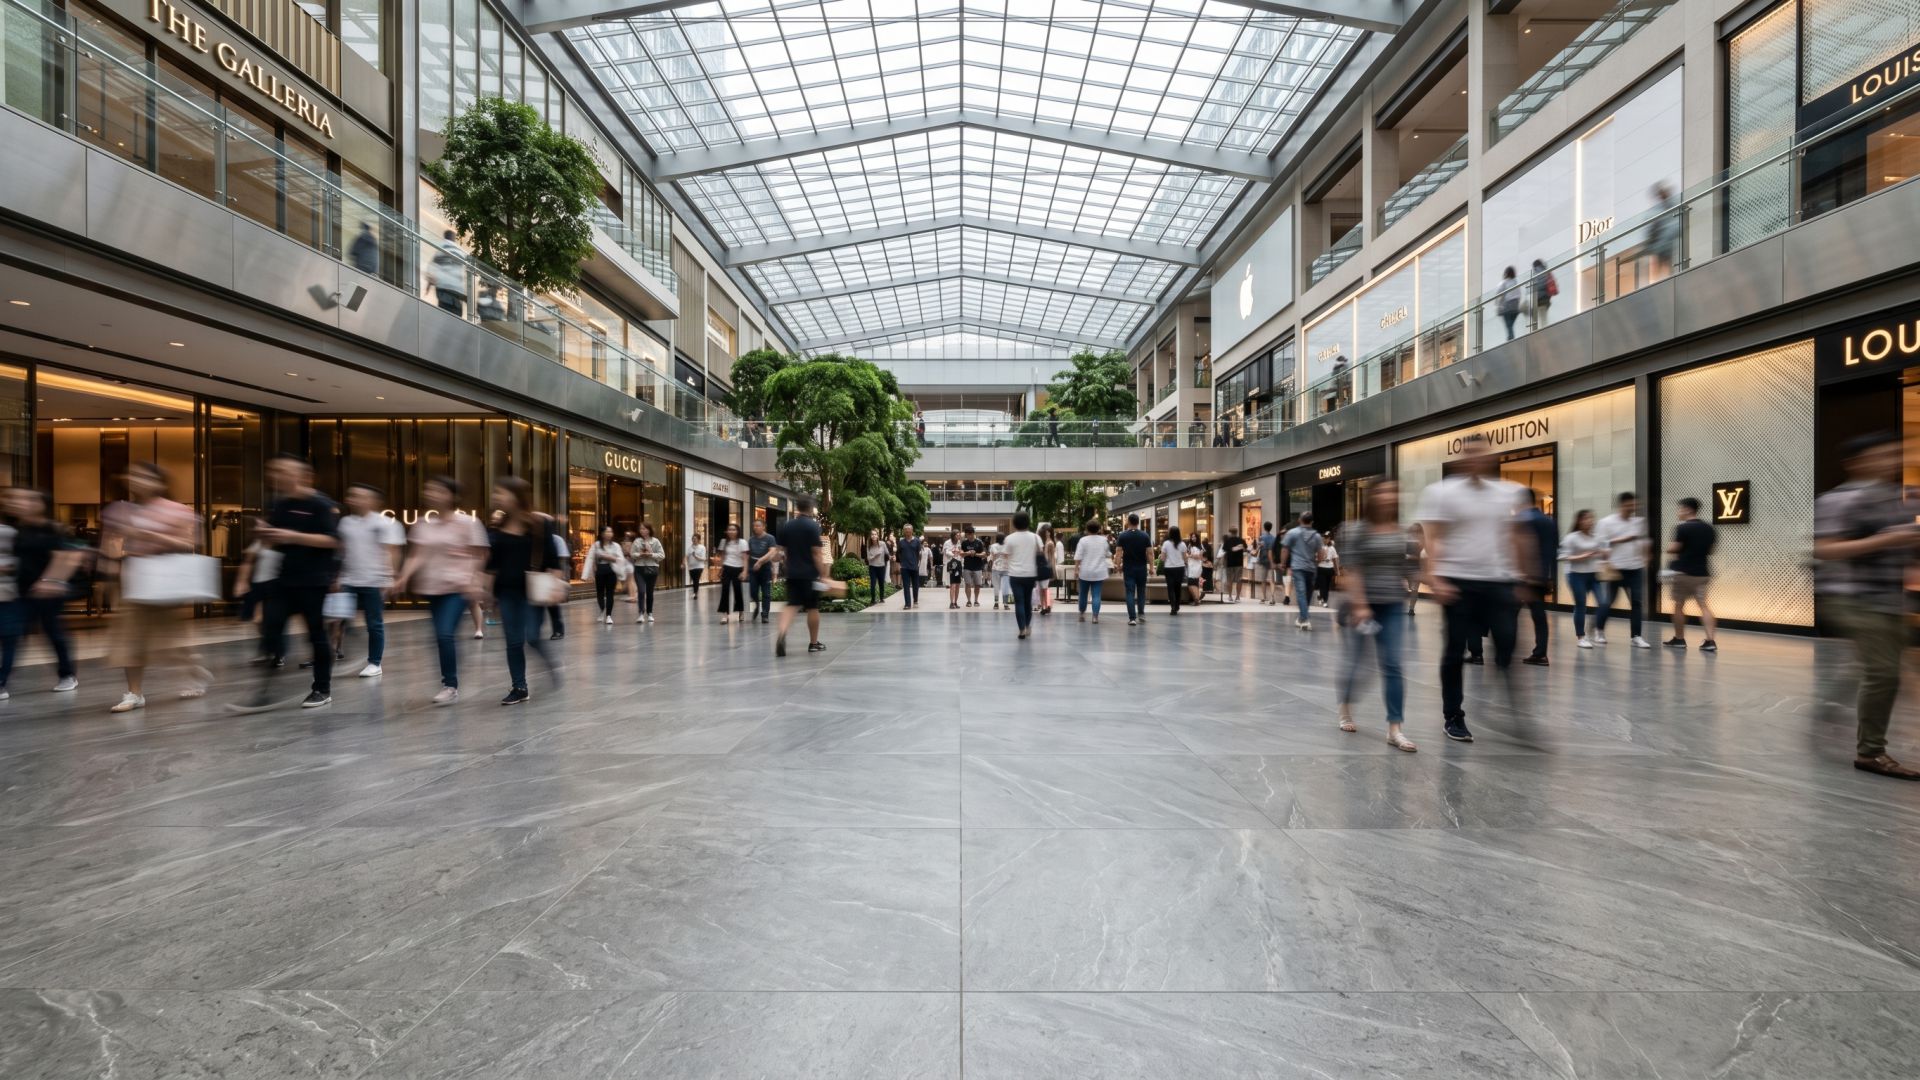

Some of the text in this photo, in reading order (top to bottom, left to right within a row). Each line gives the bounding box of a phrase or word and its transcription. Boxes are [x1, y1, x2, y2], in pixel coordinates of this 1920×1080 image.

[151, 0, 335, 139] THE GALLERIA
[1852, 50, 1920, 104] LOUIS
[1579, 216, 1613, 244] Dior
[1845, 320, 1920, 366] LOU
[1486, 417, 1549, 446] VUITTON
[605, 451, 641, 474] GUCCI
